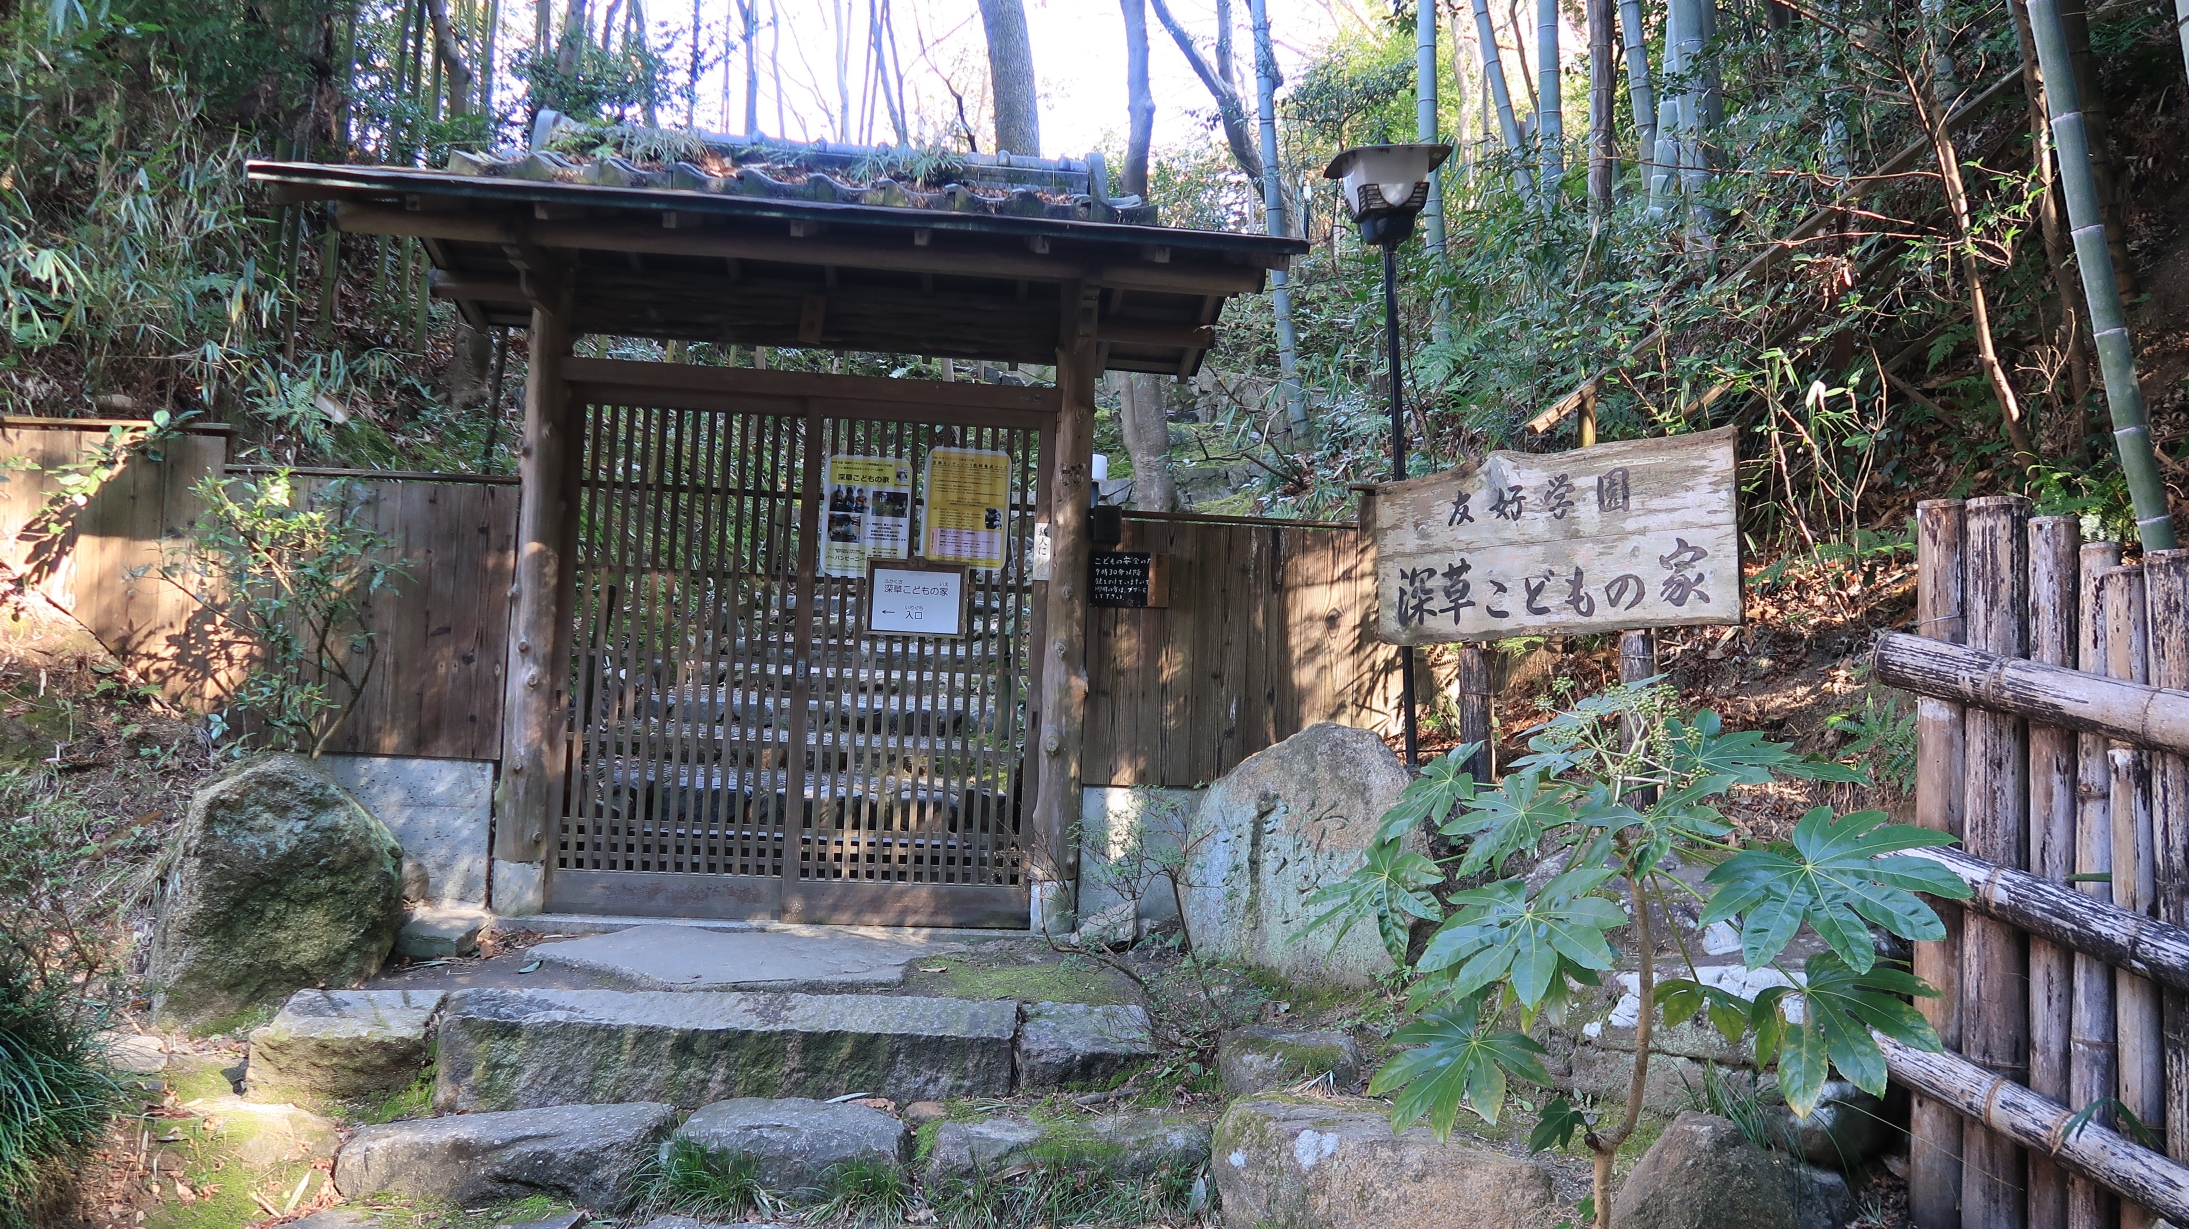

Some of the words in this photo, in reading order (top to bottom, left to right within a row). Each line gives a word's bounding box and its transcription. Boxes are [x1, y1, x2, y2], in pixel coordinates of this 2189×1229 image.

[837, 473, 890, 484] 深草こどもの家
[1448, 467, 1630, 527] 友好学園
[1398, 538, 1711, 627] 深草こどもの家
[883, 584, 949, 597] 深草こどもの家
[904, 610, 923, 620] 入口
